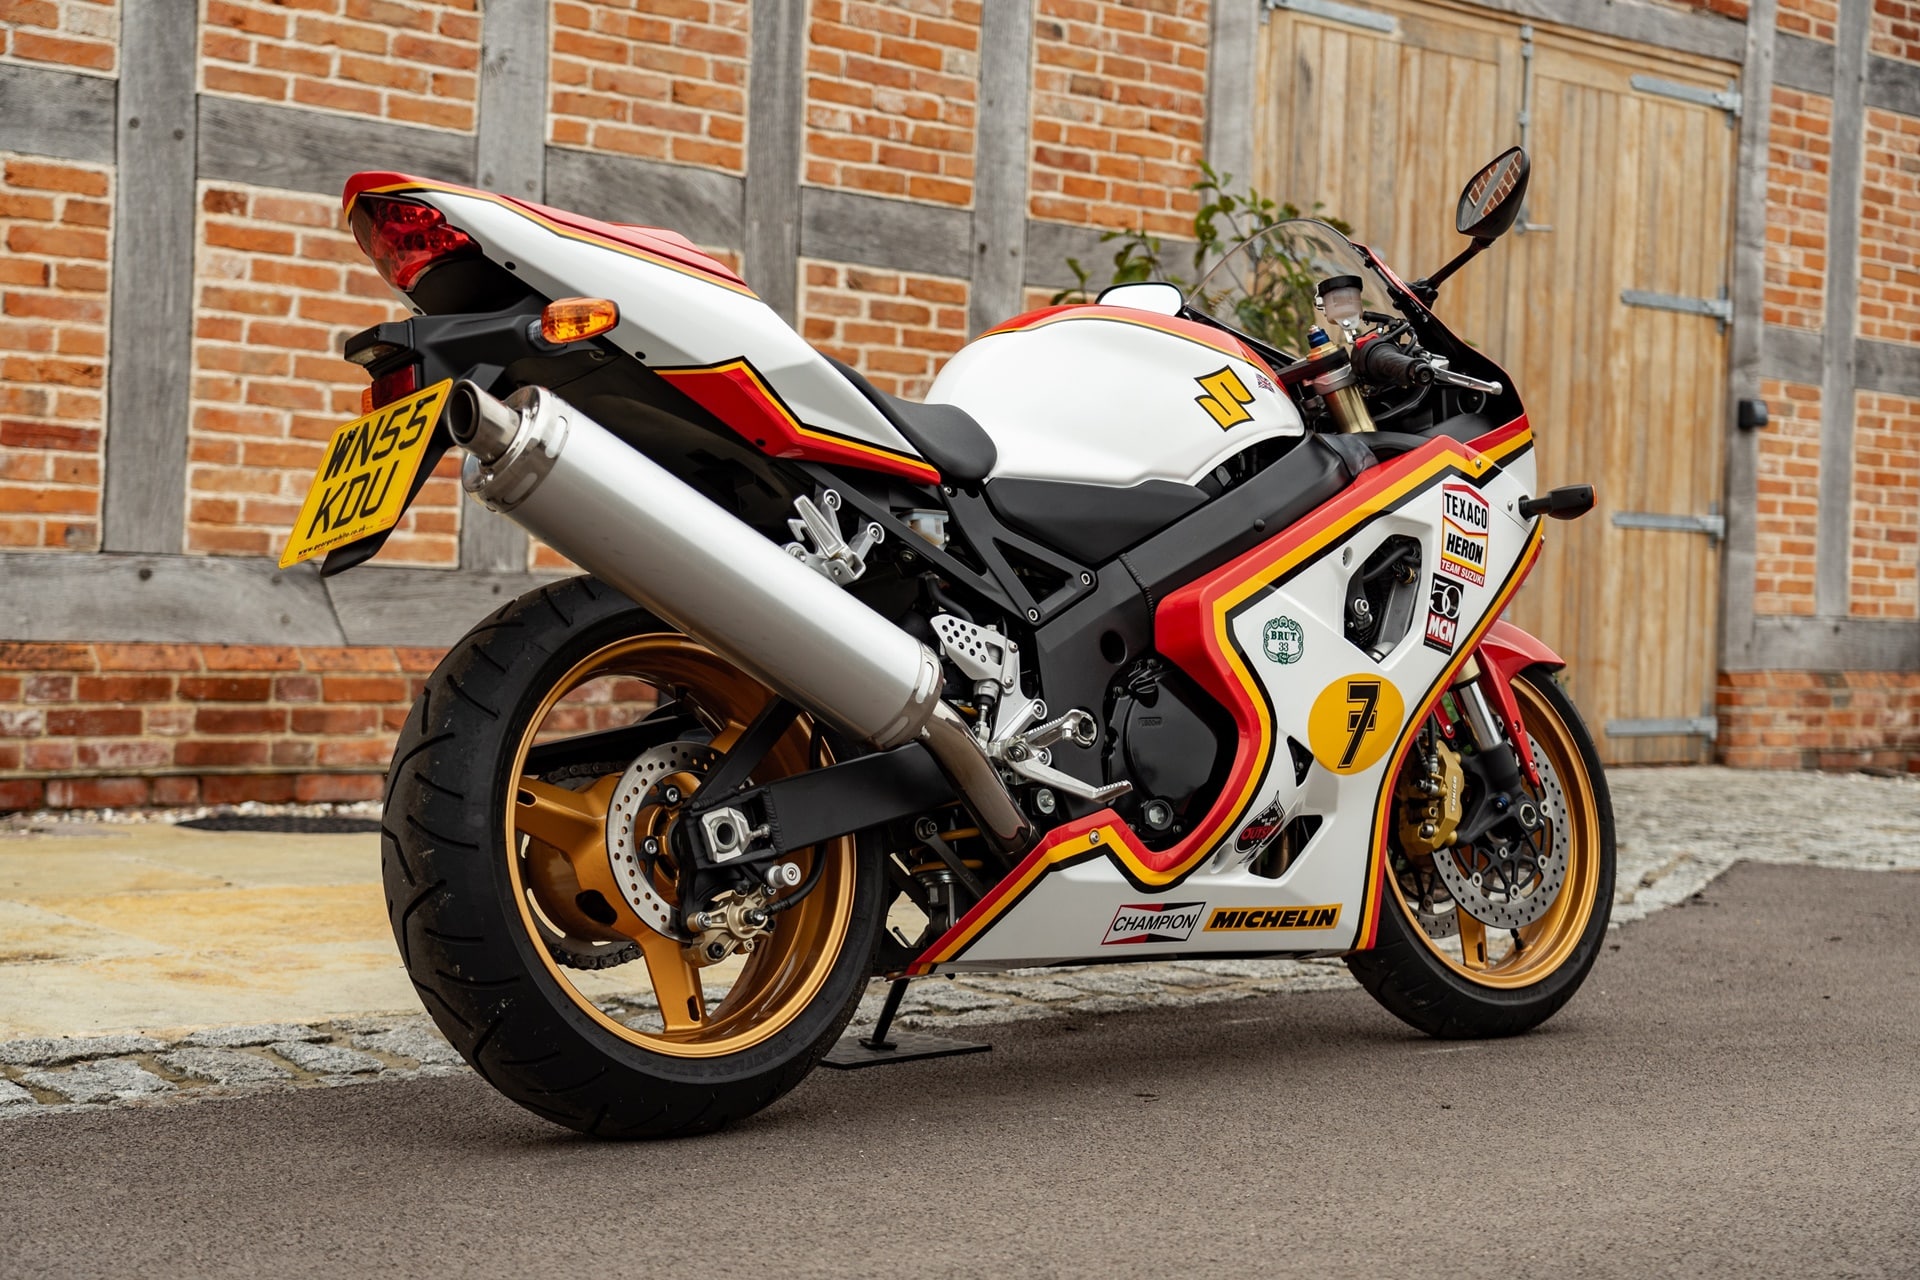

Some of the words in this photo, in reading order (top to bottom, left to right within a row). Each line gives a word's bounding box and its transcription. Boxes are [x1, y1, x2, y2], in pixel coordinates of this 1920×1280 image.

[322, 392, 438, 482] WN55
[306, 460, 399, 540] KDU
[1444, 492, 1487, 530] TEXACO
[1446, 532, 1484, 565] HERON
[1441, 560, 1461, 576] TEAM
[1461, 567, 1485, 586] SUZUKI
[1429, 578, 1461, 619] 50
[1270, 630, 1297, 642] BRUT
[1427, 614, 1456, 643] MCN
[1278, 642, 1289, 652] 33
[1337, 681, 1381, 769] 7
[1112, 913, 1197, 932] CHAMPION
[1210, 908, 1337, 929] MICHELIN
